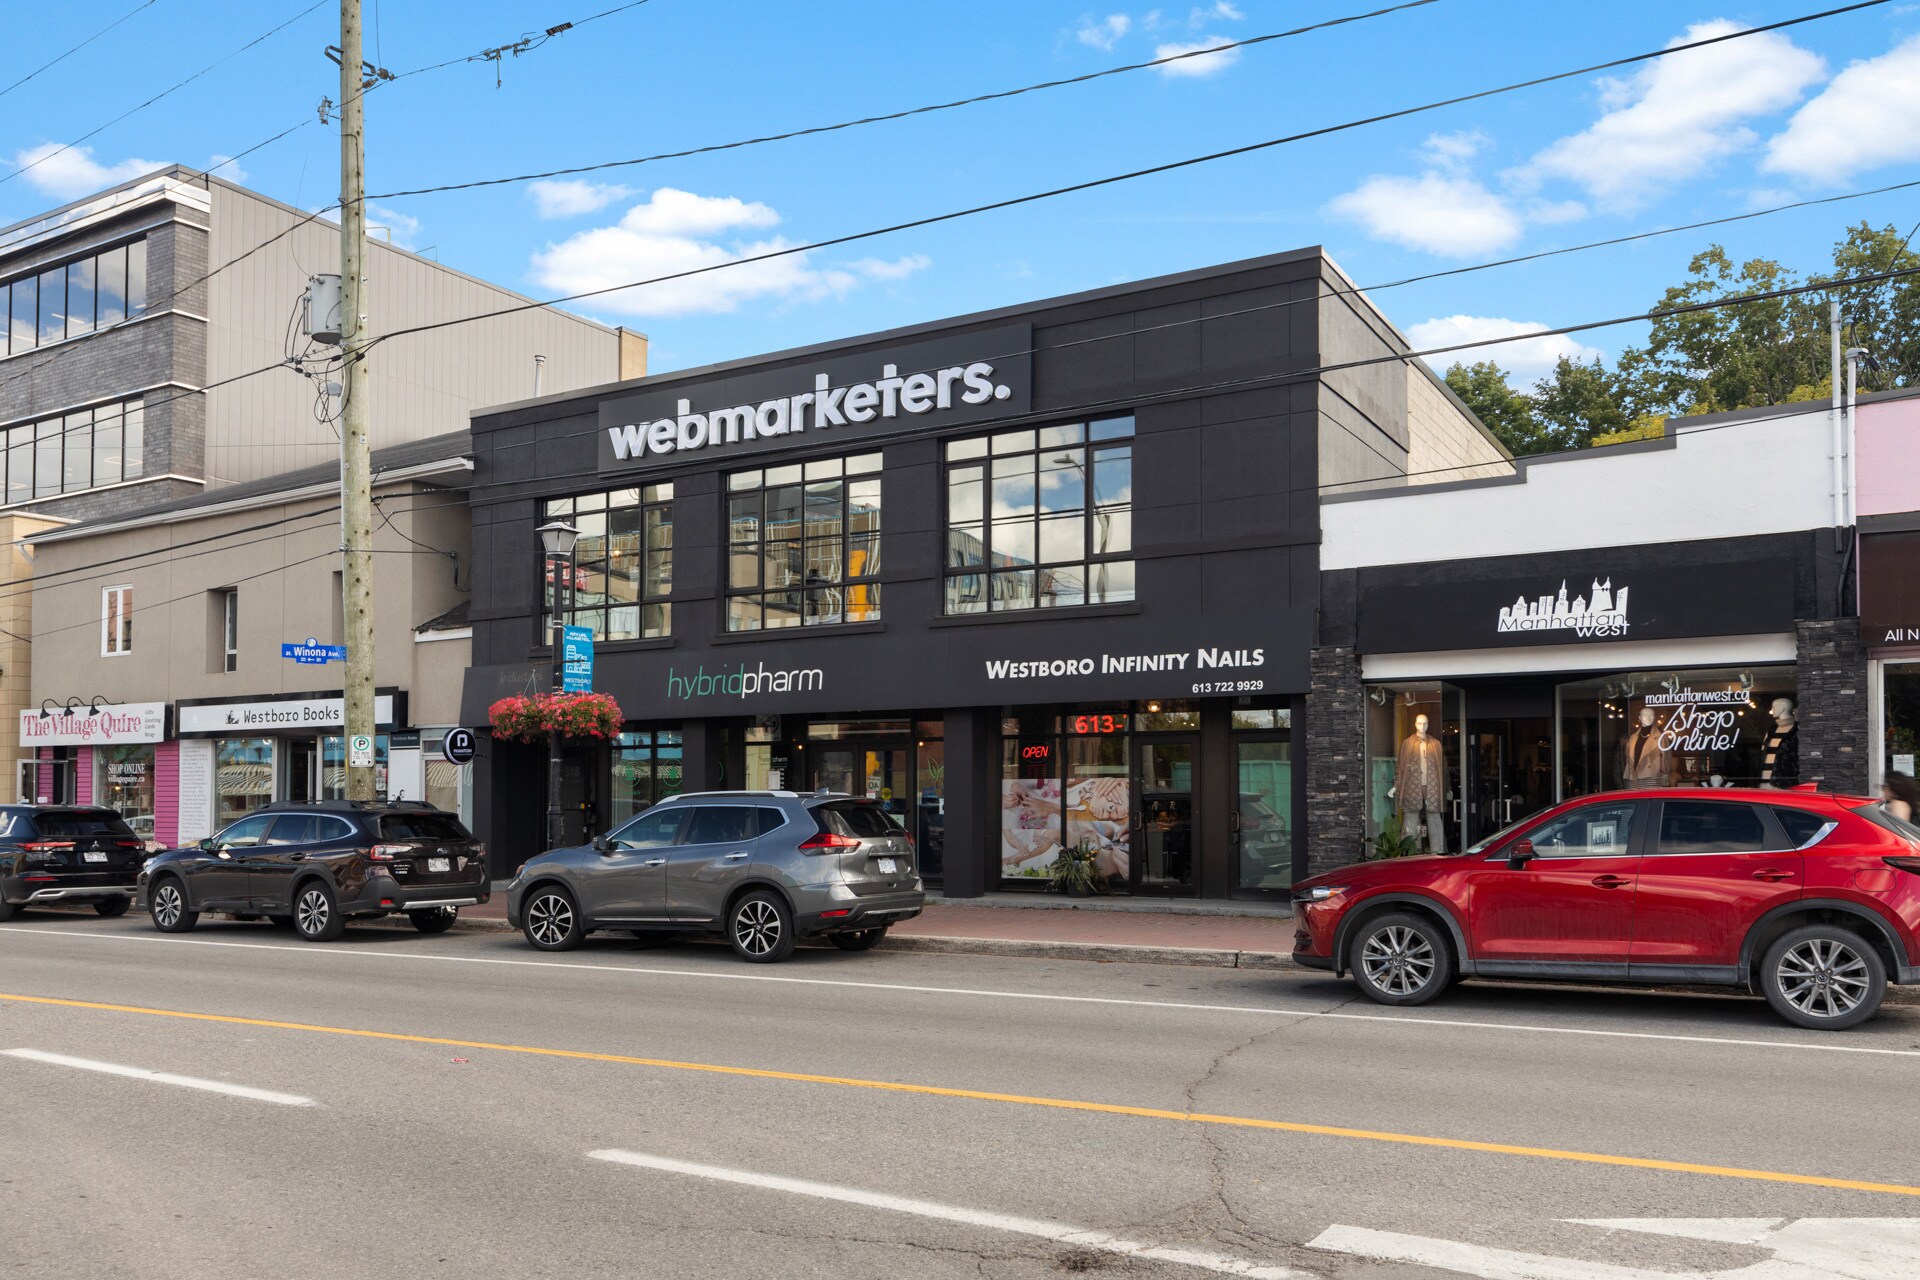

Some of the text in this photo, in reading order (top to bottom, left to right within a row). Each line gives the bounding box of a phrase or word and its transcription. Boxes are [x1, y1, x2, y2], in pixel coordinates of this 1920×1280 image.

[608, 362, 1011, 460] webmarketers.
[1499, 612, 1625, 631] Manhattan
[1575, 620, 1630, 637] west
[1884, 628, 1904, 642] All
[293, 646, 326, 656] Winona
[986, 647, 1265, 680] WESTBORO INFINITY NAILS
[667, 661, 824, 700] hybridpharm
[1192, 680, 1264, 694] 613 722 9929
[1645, 685, 1750, 704] manhattanwest.ca
[243, 706, 340, 724] Westboro Books
[1075, 713, 1127, 734] 613-
[1663, 703, 1735, 736] Shop
[23, 711, 142, 740] The Village Quire
[1657, 727, 1740, 752] Online!
[1022, 745, 1049, 759] OPEN
[108, 763, 146, 775] SHOP ONLINE
[108, 775, 145, 783] villagequire.ca
